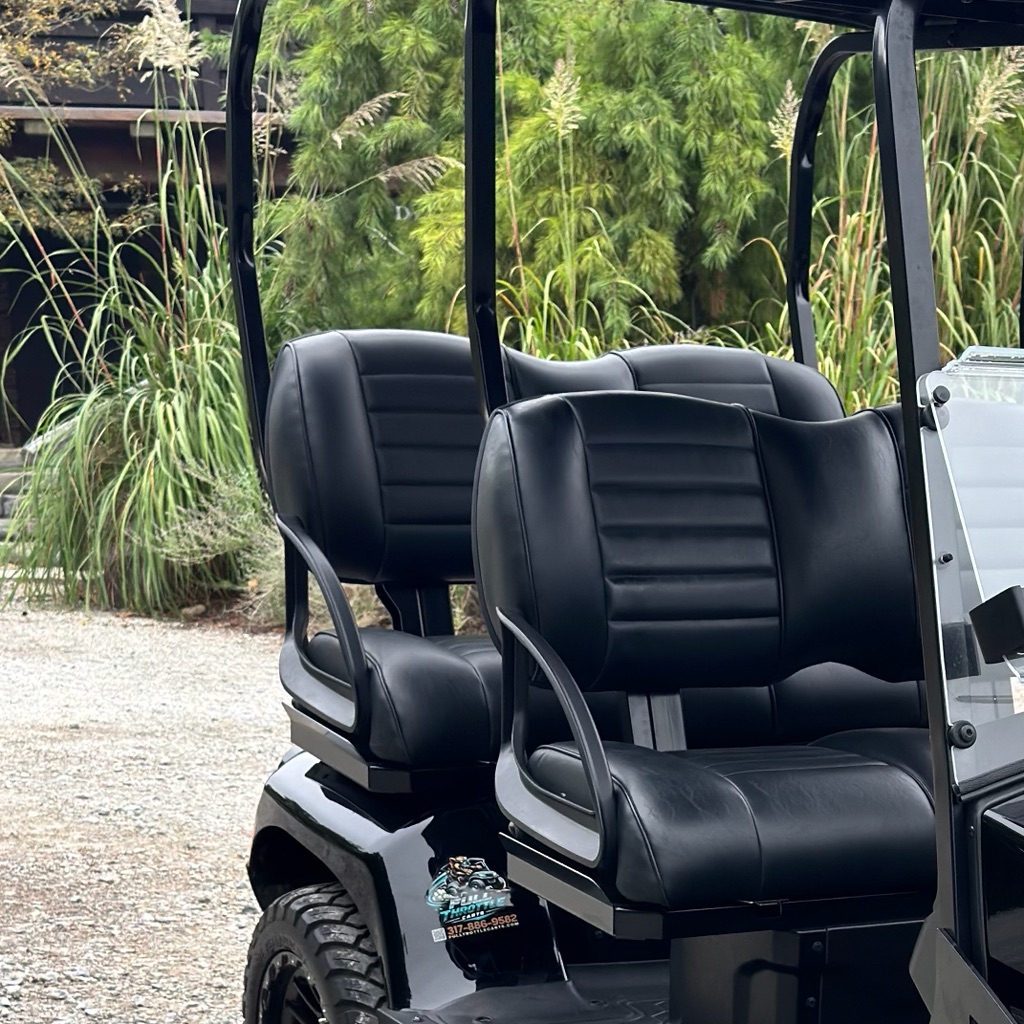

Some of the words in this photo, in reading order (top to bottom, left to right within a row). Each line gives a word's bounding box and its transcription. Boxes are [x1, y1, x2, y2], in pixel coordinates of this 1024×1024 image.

[441, 898, 506, 922] THROTTLE
[449, 893, 492, 909] FULL
[447, 915, 518, 935] 317-886-9582
